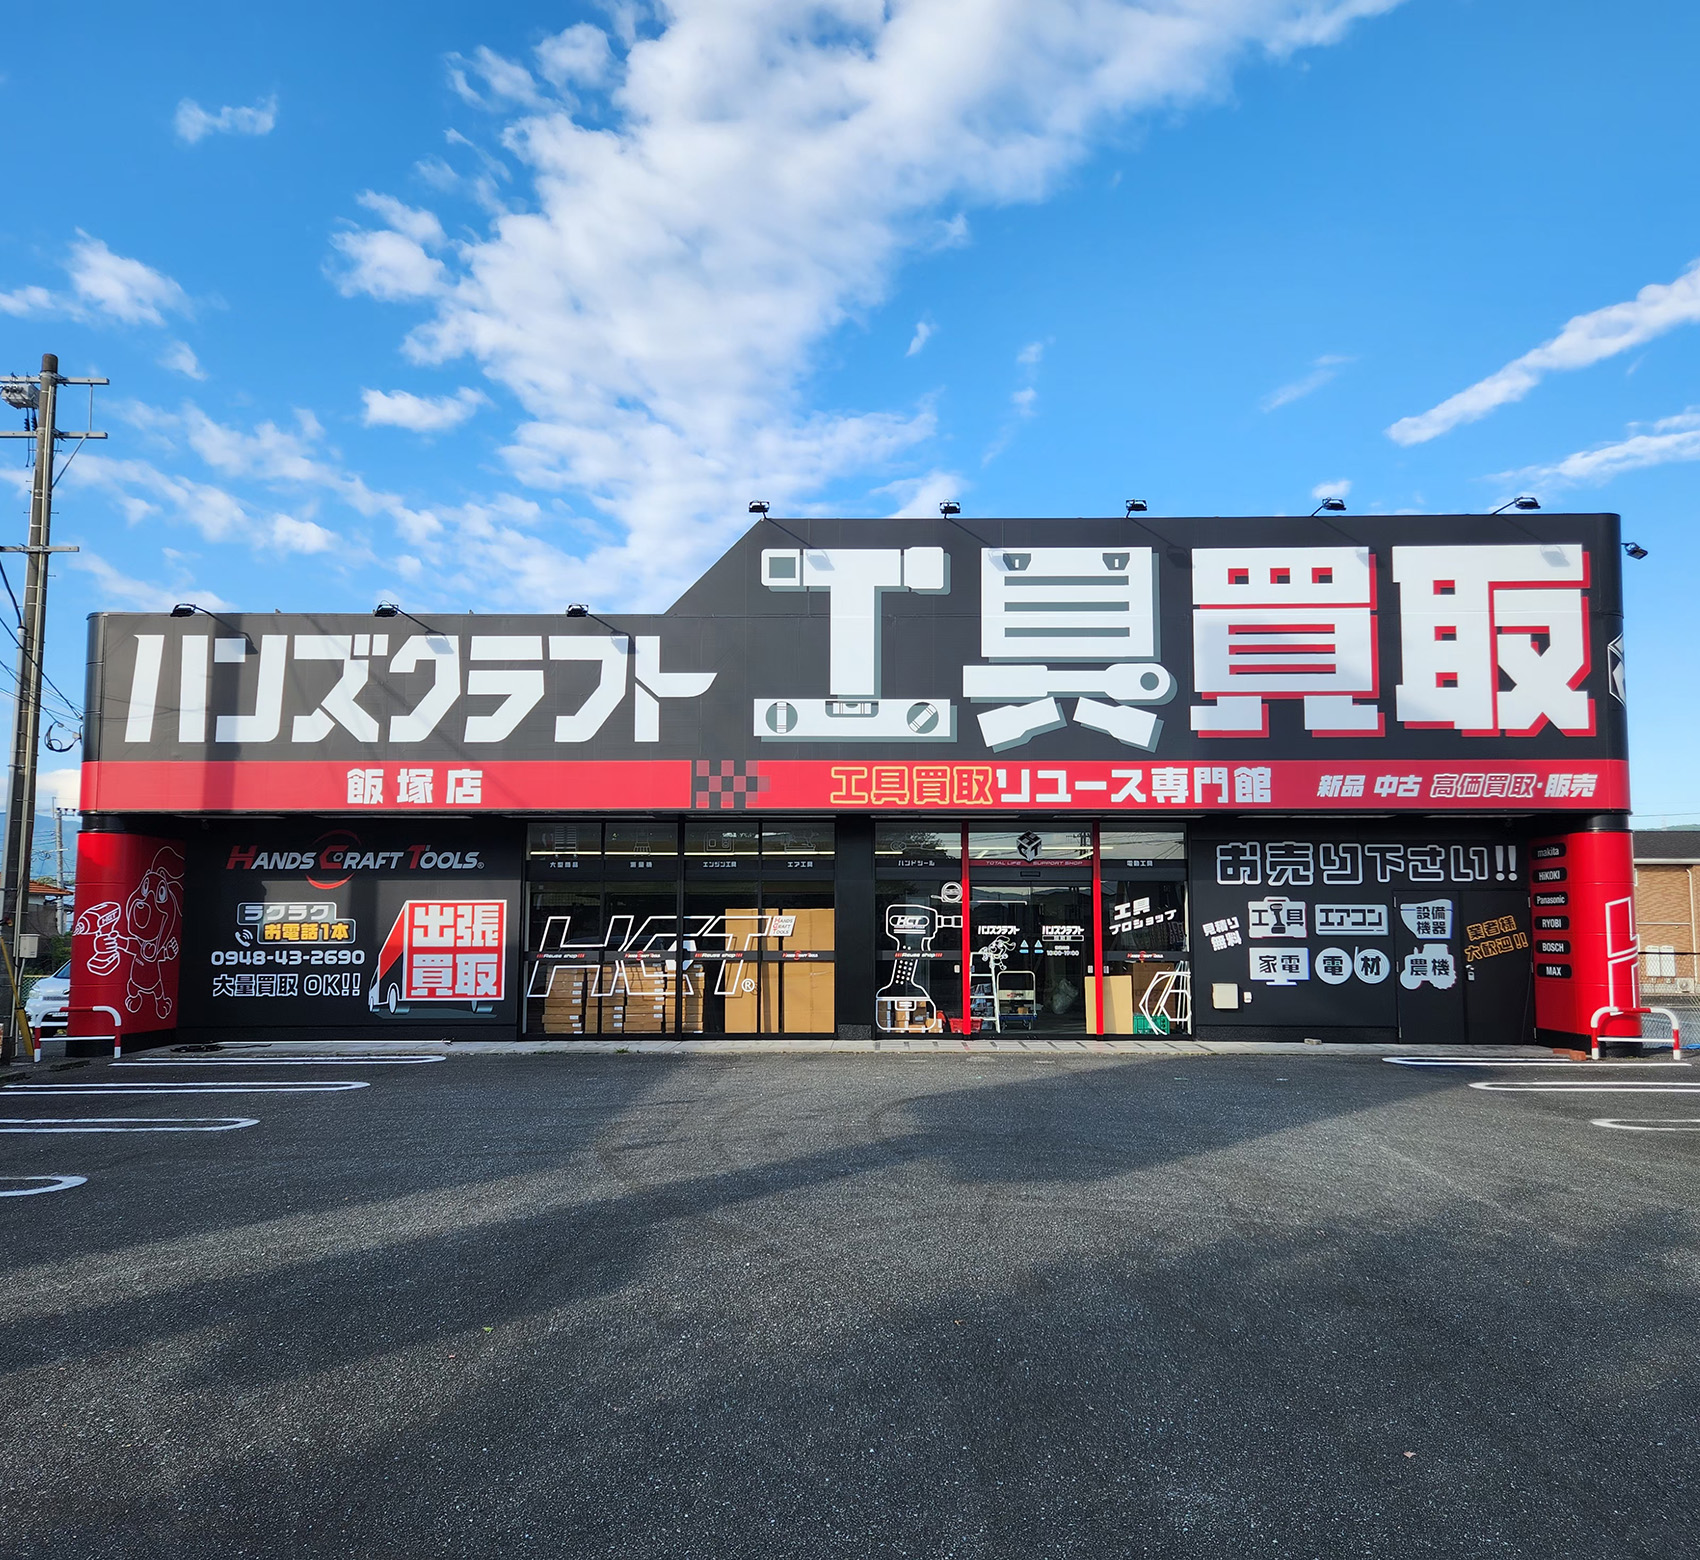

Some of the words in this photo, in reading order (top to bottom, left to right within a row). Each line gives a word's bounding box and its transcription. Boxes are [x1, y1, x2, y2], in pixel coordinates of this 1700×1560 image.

[753, 544, 1595, 752] 工具買取
[124, 634, 717, 743] ハンズクラフト
[347, 768, 483, 804] 飯塚店
[830, 766, 1272, 804] 工具買取リユース専門館
[1317, 775, 1366, 797] 新品
[1373, 775, 1422, 797] 中古
[1537, 845, 1560, 857] makita
[1114, 897, 1150, 920] 工具
[1537, 895, 1565, 905] Panasonic
[244, 905, 329, 921] ラクラク
[1319, 909, 1382, 926] エアコン
[1416, 906, 1446, 920] 設備
[264, 923, 349, 940] お電話1本
[412, 905, 500, 948] 出張
[1416, 921, 1446, 935] 機器
[1542, 919, 1562, 928] RYOBI
[1542, 942, 1564, 952] BOSCH
[211, 950, 365, 965] 0948-43-2690
[1259, 955, 1300, 974] 家電
[411, 954, 498, 997] 買取
[1410, 959, 1450, 976] 農機
[1546, 963, 1562, 976] MAX
[213, 974, 298, 997] 大量買取
[303, 973, 361, 997] OK!!
